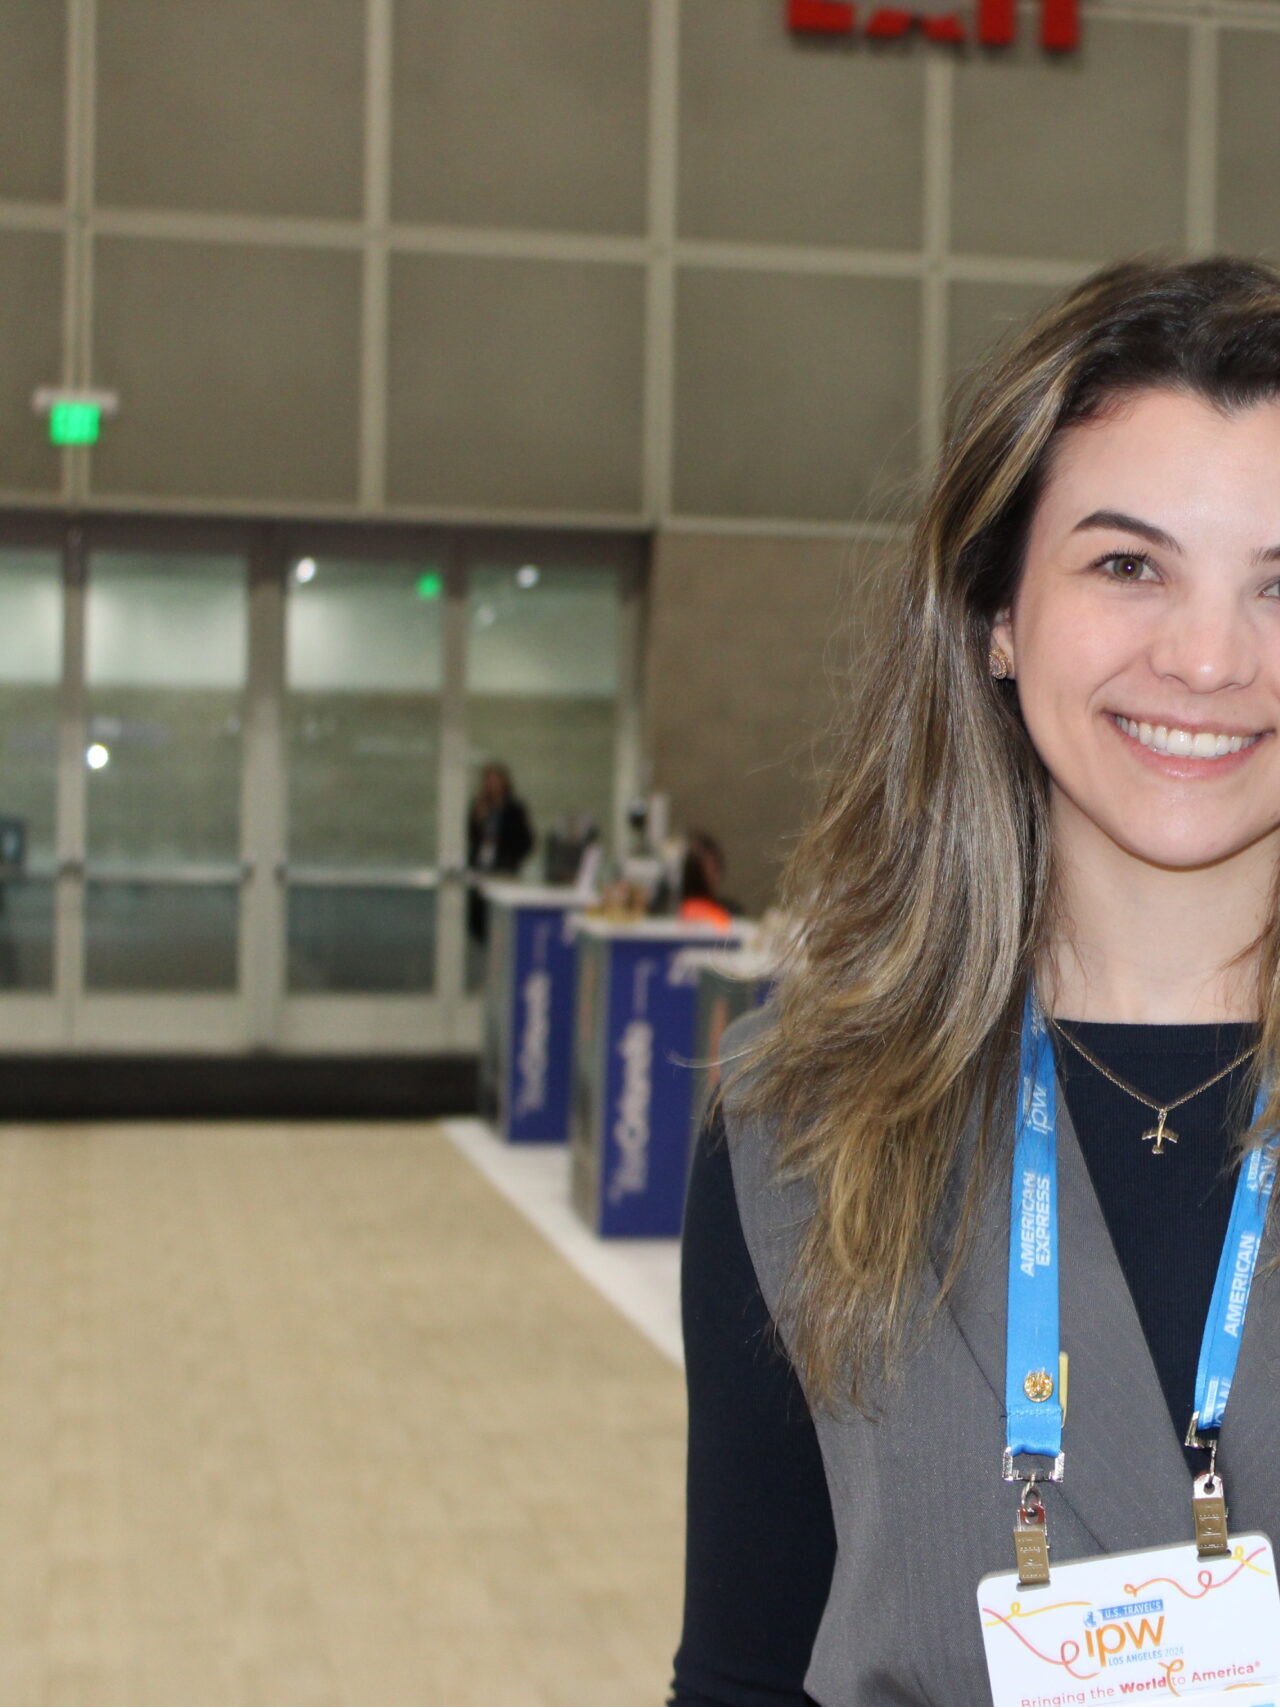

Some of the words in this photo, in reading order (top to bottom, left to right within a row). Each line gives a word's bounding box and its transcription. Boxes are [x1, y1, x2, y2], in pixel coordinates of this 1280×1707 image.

[1030, 1082, 1054, 1136] ipw
[1020, 1171, 1036, 1278] AMERICAN
[1034, 1173, 1051, 1267] EXPRESS
[1222, 1231, 1257, 1340] AMERICAN
[1123, 1600, 1161, 1616] TRAVEL'S
[1084, 1615, 1165, 1668] ipw
[1108, 1656, 1124, 1667] LOS
[1126, 1649, 1163, 1662] ANGELES
[1164, 1645, 1185, 1657] 2024
[1020, 1691, 1086, 1707] Bringing
[1090, 1686, 1115, 1700] the
[1119, 1676, 1167, 1694] World
[1171, 1676, 1187, 1687] to
